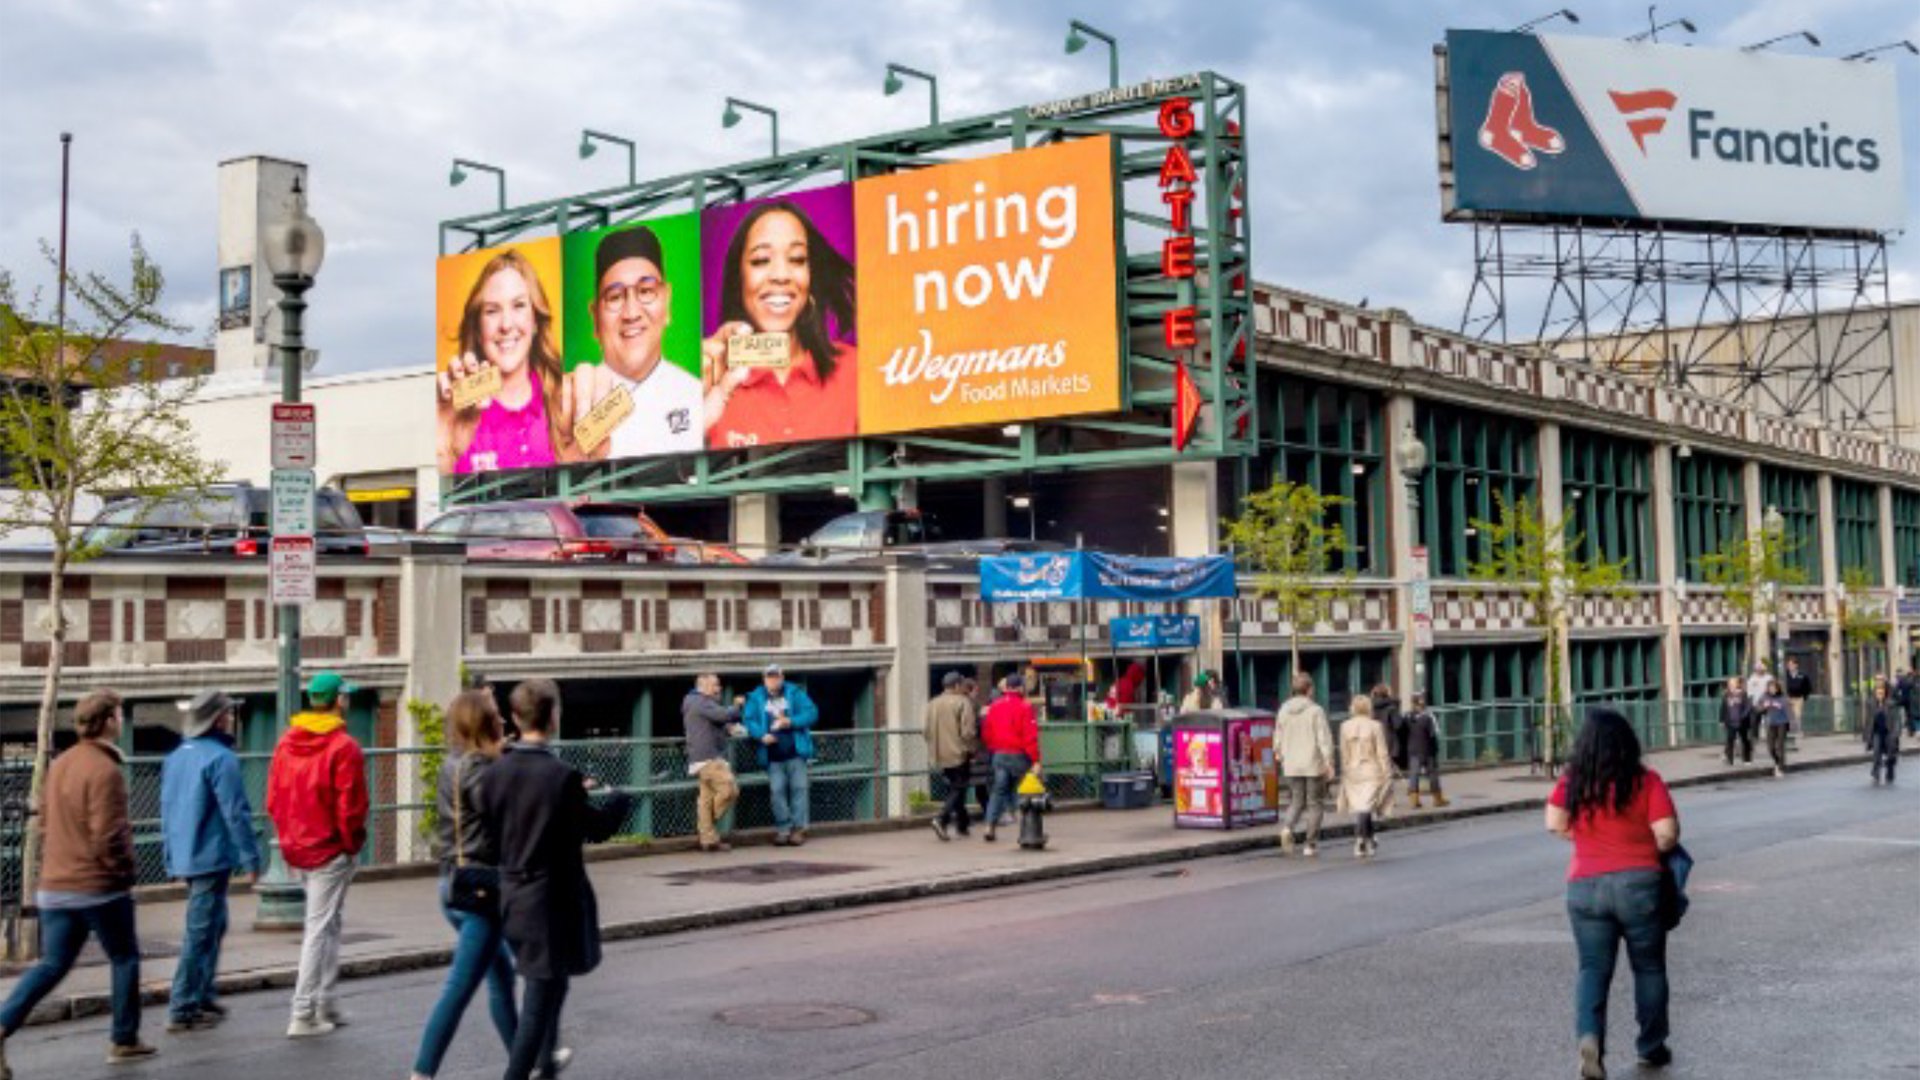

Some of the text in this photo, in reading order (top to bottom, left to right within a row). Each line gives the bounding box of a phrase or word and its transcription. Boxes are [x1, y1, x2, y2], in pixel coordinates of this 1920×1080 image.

[1688, 107, 1881, 173] Fanatics
[886, 181, 1078, 255] hiring
[1158, 97, 1198, 350] GATE E
[913, 253, 1054, 314] now
[879, 328, 1067, 405] Wegmans
[960, 373, 1091, 404] Food Markets
